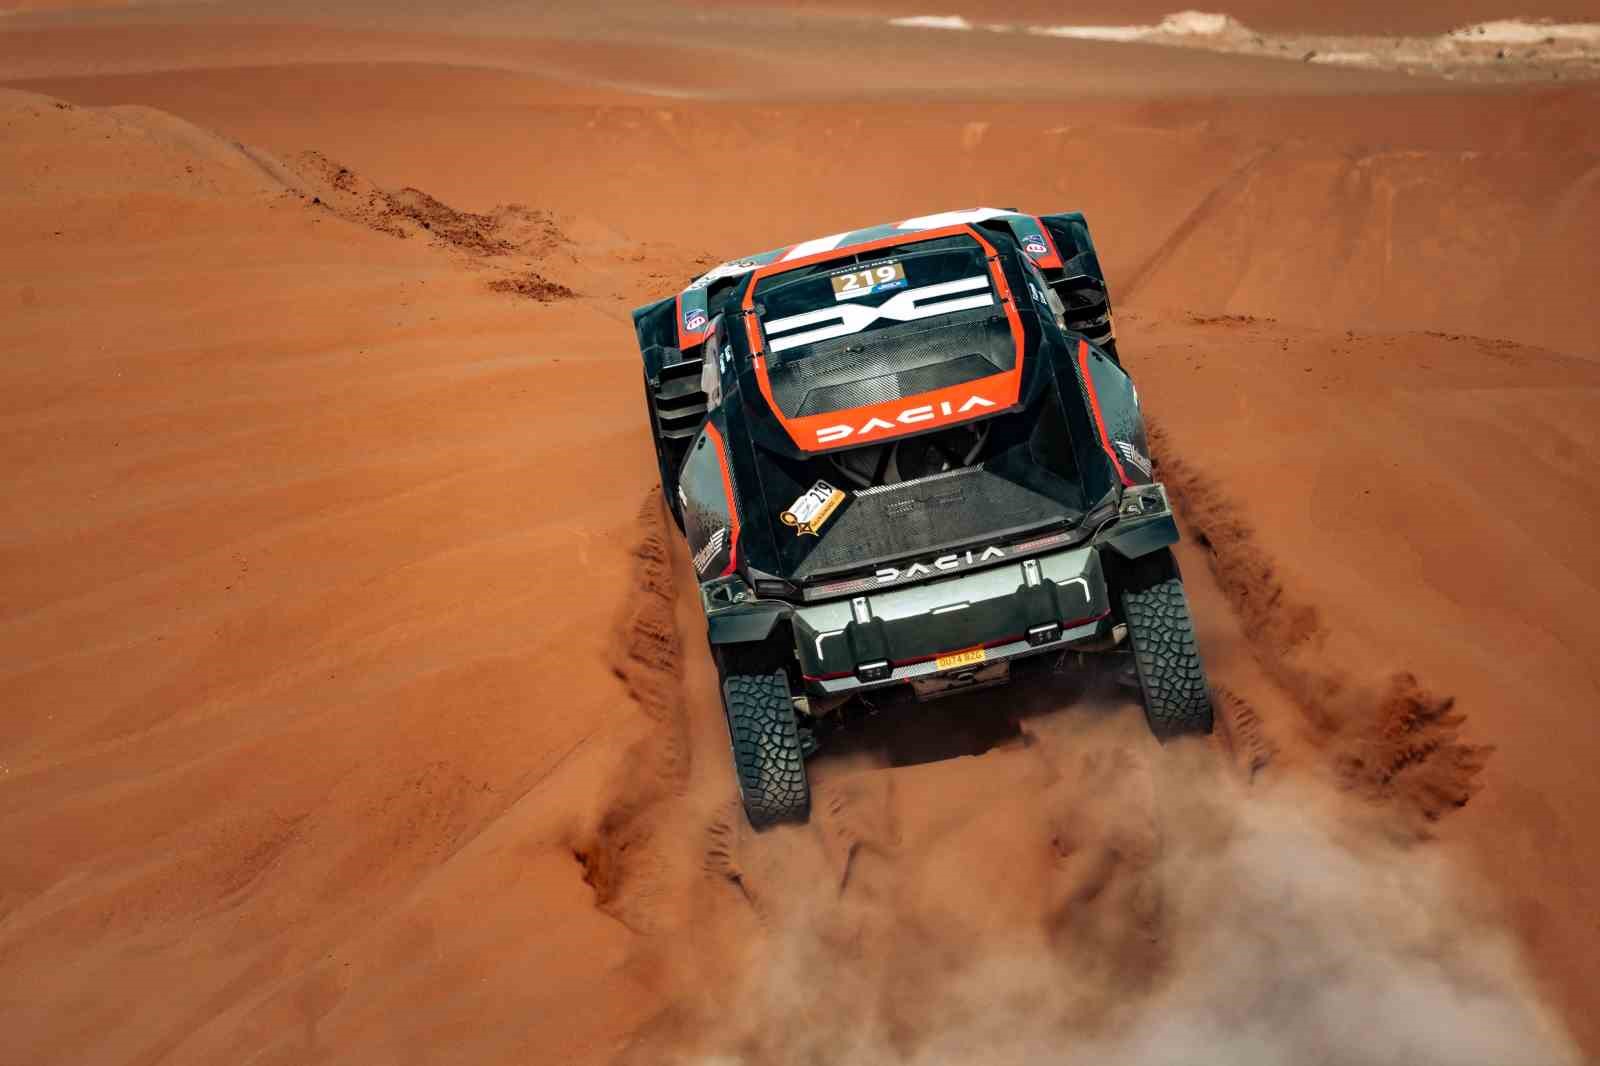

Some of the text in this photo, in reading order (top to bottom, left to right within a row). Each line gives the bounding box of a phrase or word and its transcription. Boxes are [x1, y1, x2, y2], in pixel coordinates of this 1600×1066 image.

[840, 265, 896, 291] 219
[816, 395, 996, 443] DACIA
[810, 481, 833, 503] 219
[876, 546, 1005, 583] DACIA
